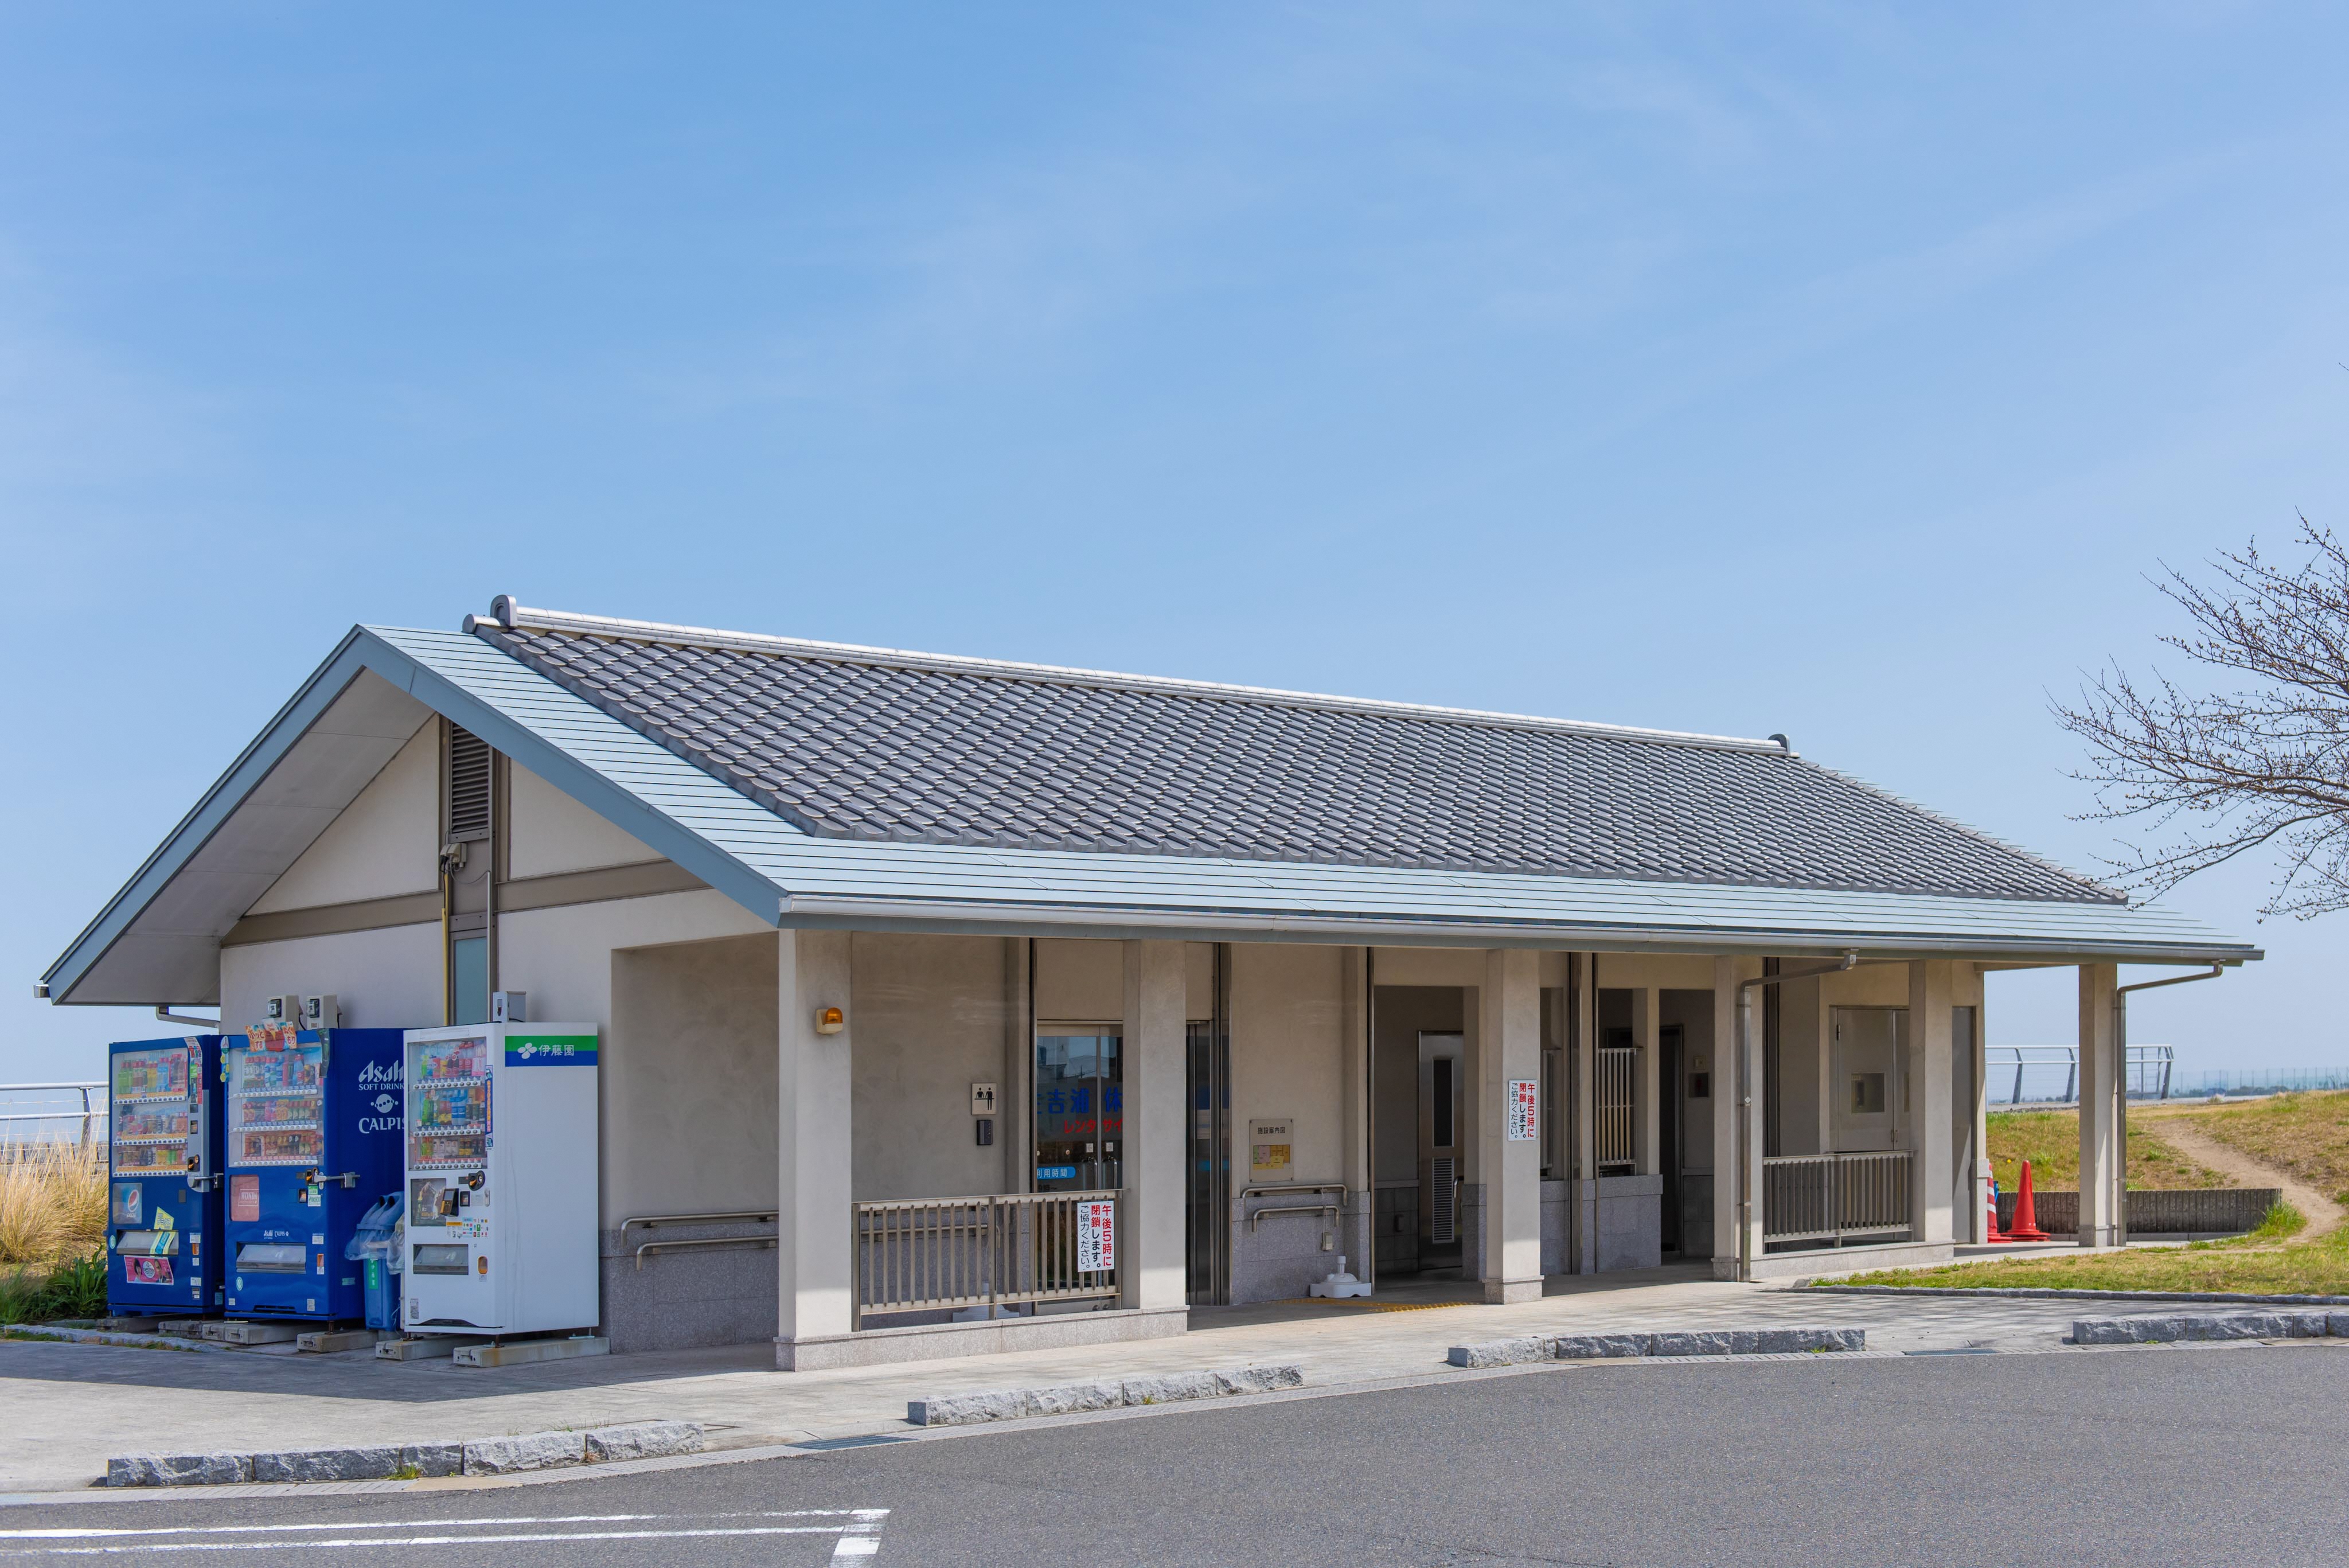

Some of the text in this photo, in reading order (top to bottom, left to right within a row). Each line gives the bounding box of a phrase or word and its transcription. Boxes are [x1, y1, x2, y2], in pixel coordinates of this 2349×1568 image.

[358, 1059, 404, 1083] Asah
[539, 1044, 574, 1056] 伊藤園
[1258, 1126, 1285, 1134] 施設案内図
[1527, 1083, 1535, 1138] 午後5時に
[1080, 1205, 1090, 1268] ご協力ください。
[1091, 1205, 1101, 1267] 閉鎖します。
[1102, 1205, 1111, 1266] 午後5時に
